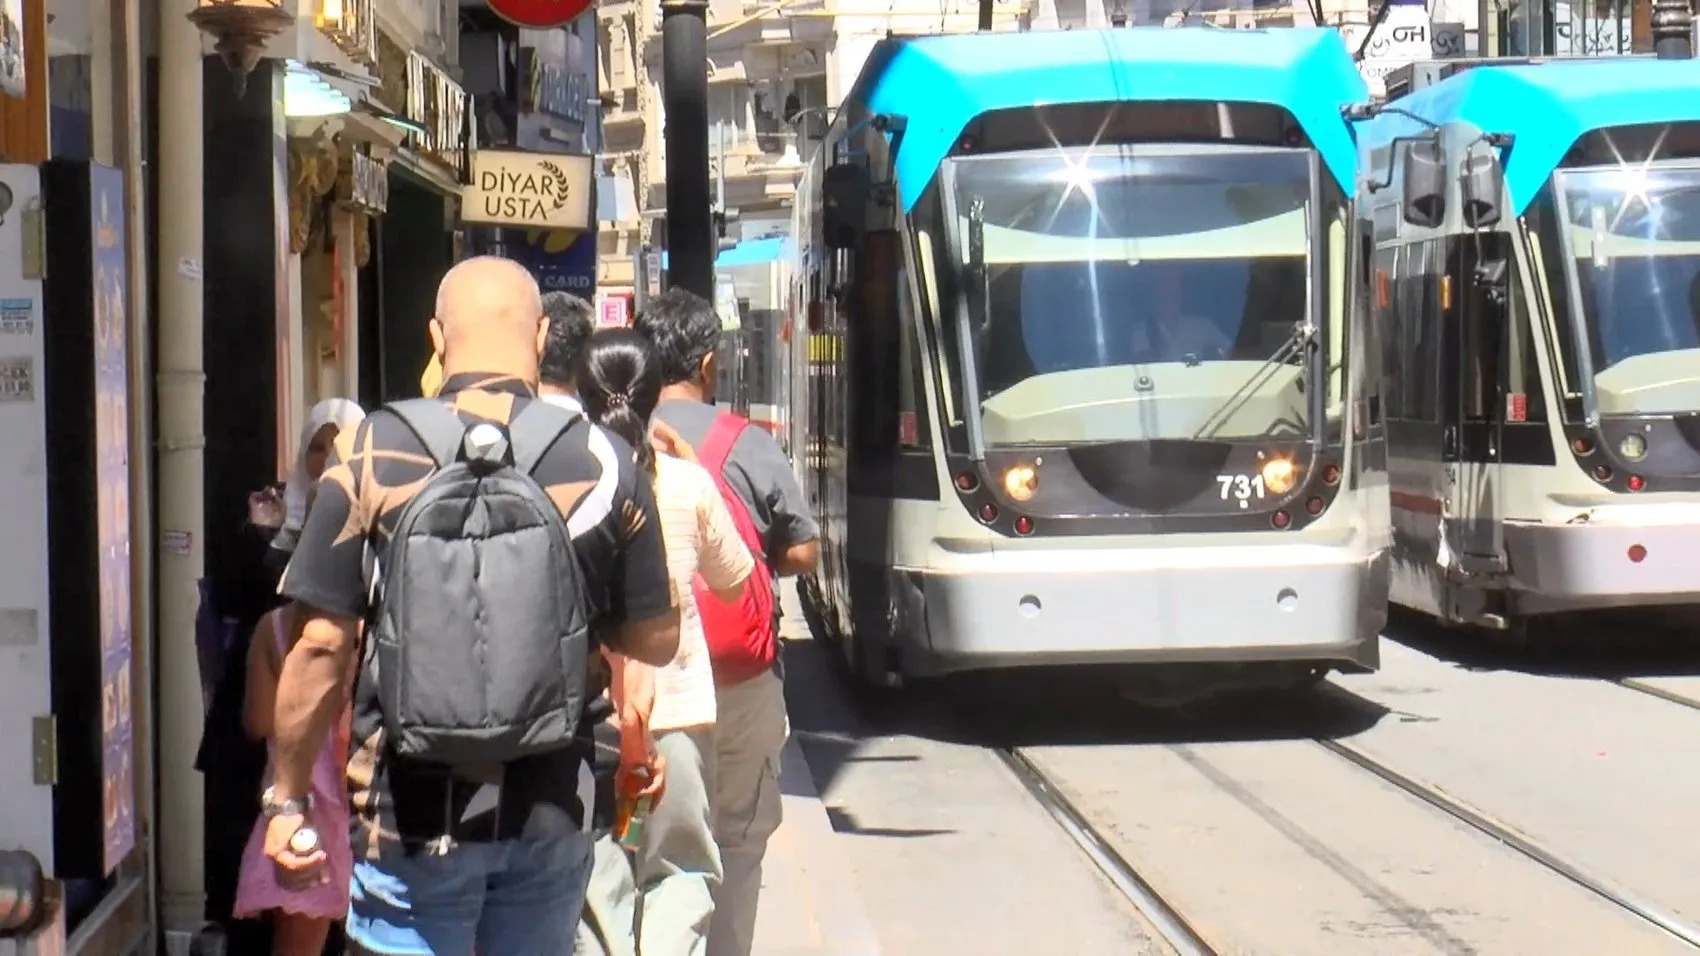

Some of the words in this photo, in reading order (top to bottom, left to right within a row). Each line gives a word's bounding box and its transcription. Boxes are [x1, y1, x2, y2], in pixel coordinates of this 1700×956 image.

[481, 166, 553, 197] DİYAR
[485, 196, 547, 220] USTA
[544, 275, 590, 288] CARD
[1216, 474, 1265, 499] 731
